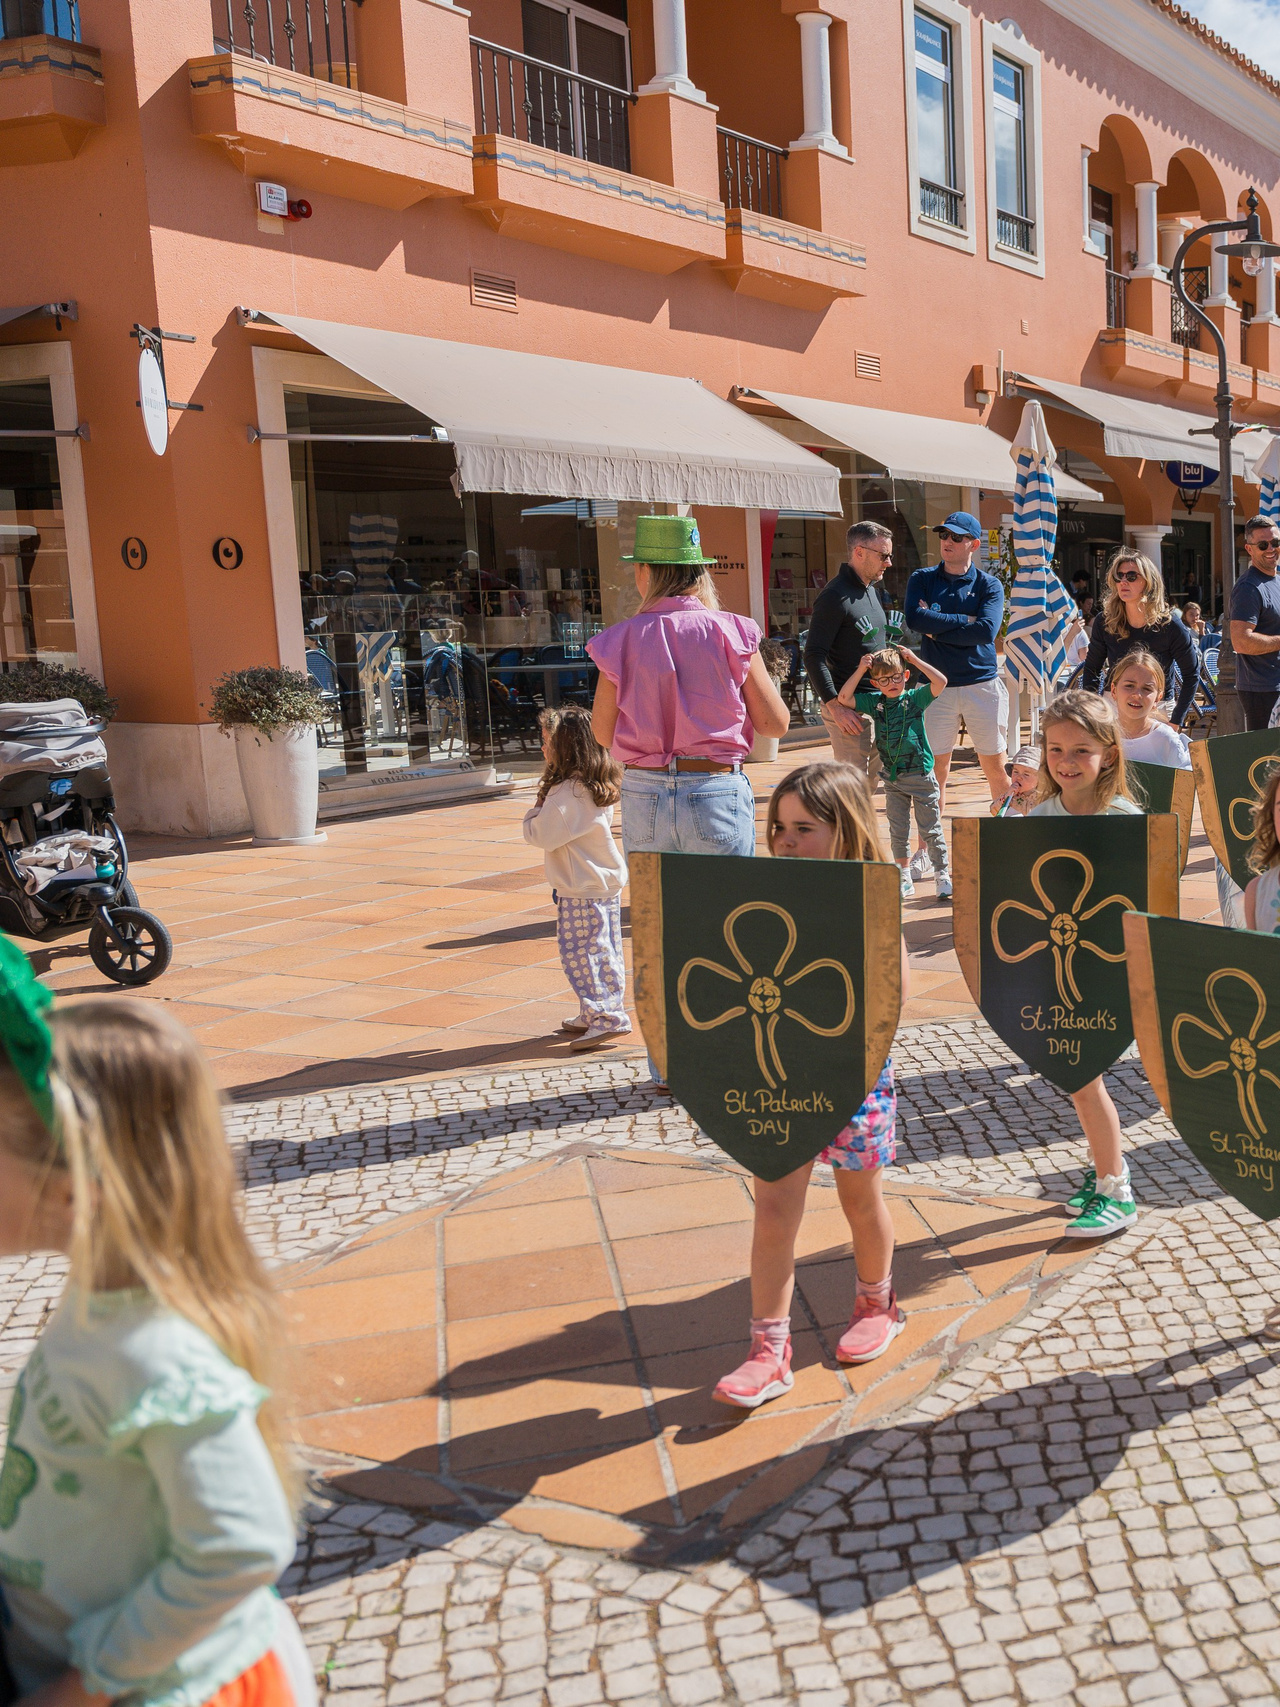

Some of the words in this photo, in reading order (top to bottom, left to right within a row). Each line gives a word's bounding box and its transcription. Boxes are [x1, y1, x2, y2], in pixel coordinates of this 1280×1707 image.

[1184, 465, 1200, 475] blu
[1061, 520, 1085, 533] TONY'S
[704, 562, 745, 570] RIZONTE
[1020, 1005, 1052, 1031] St.
[1046, 1038, 1081, 1066] DAY
[724, 1089, 757, 1115] St.
[746, 1119, 790, 1146] DAY
[1209, 1130, 1237, 1154] St.
[1234, 1158, 1274, 1192] DAY
